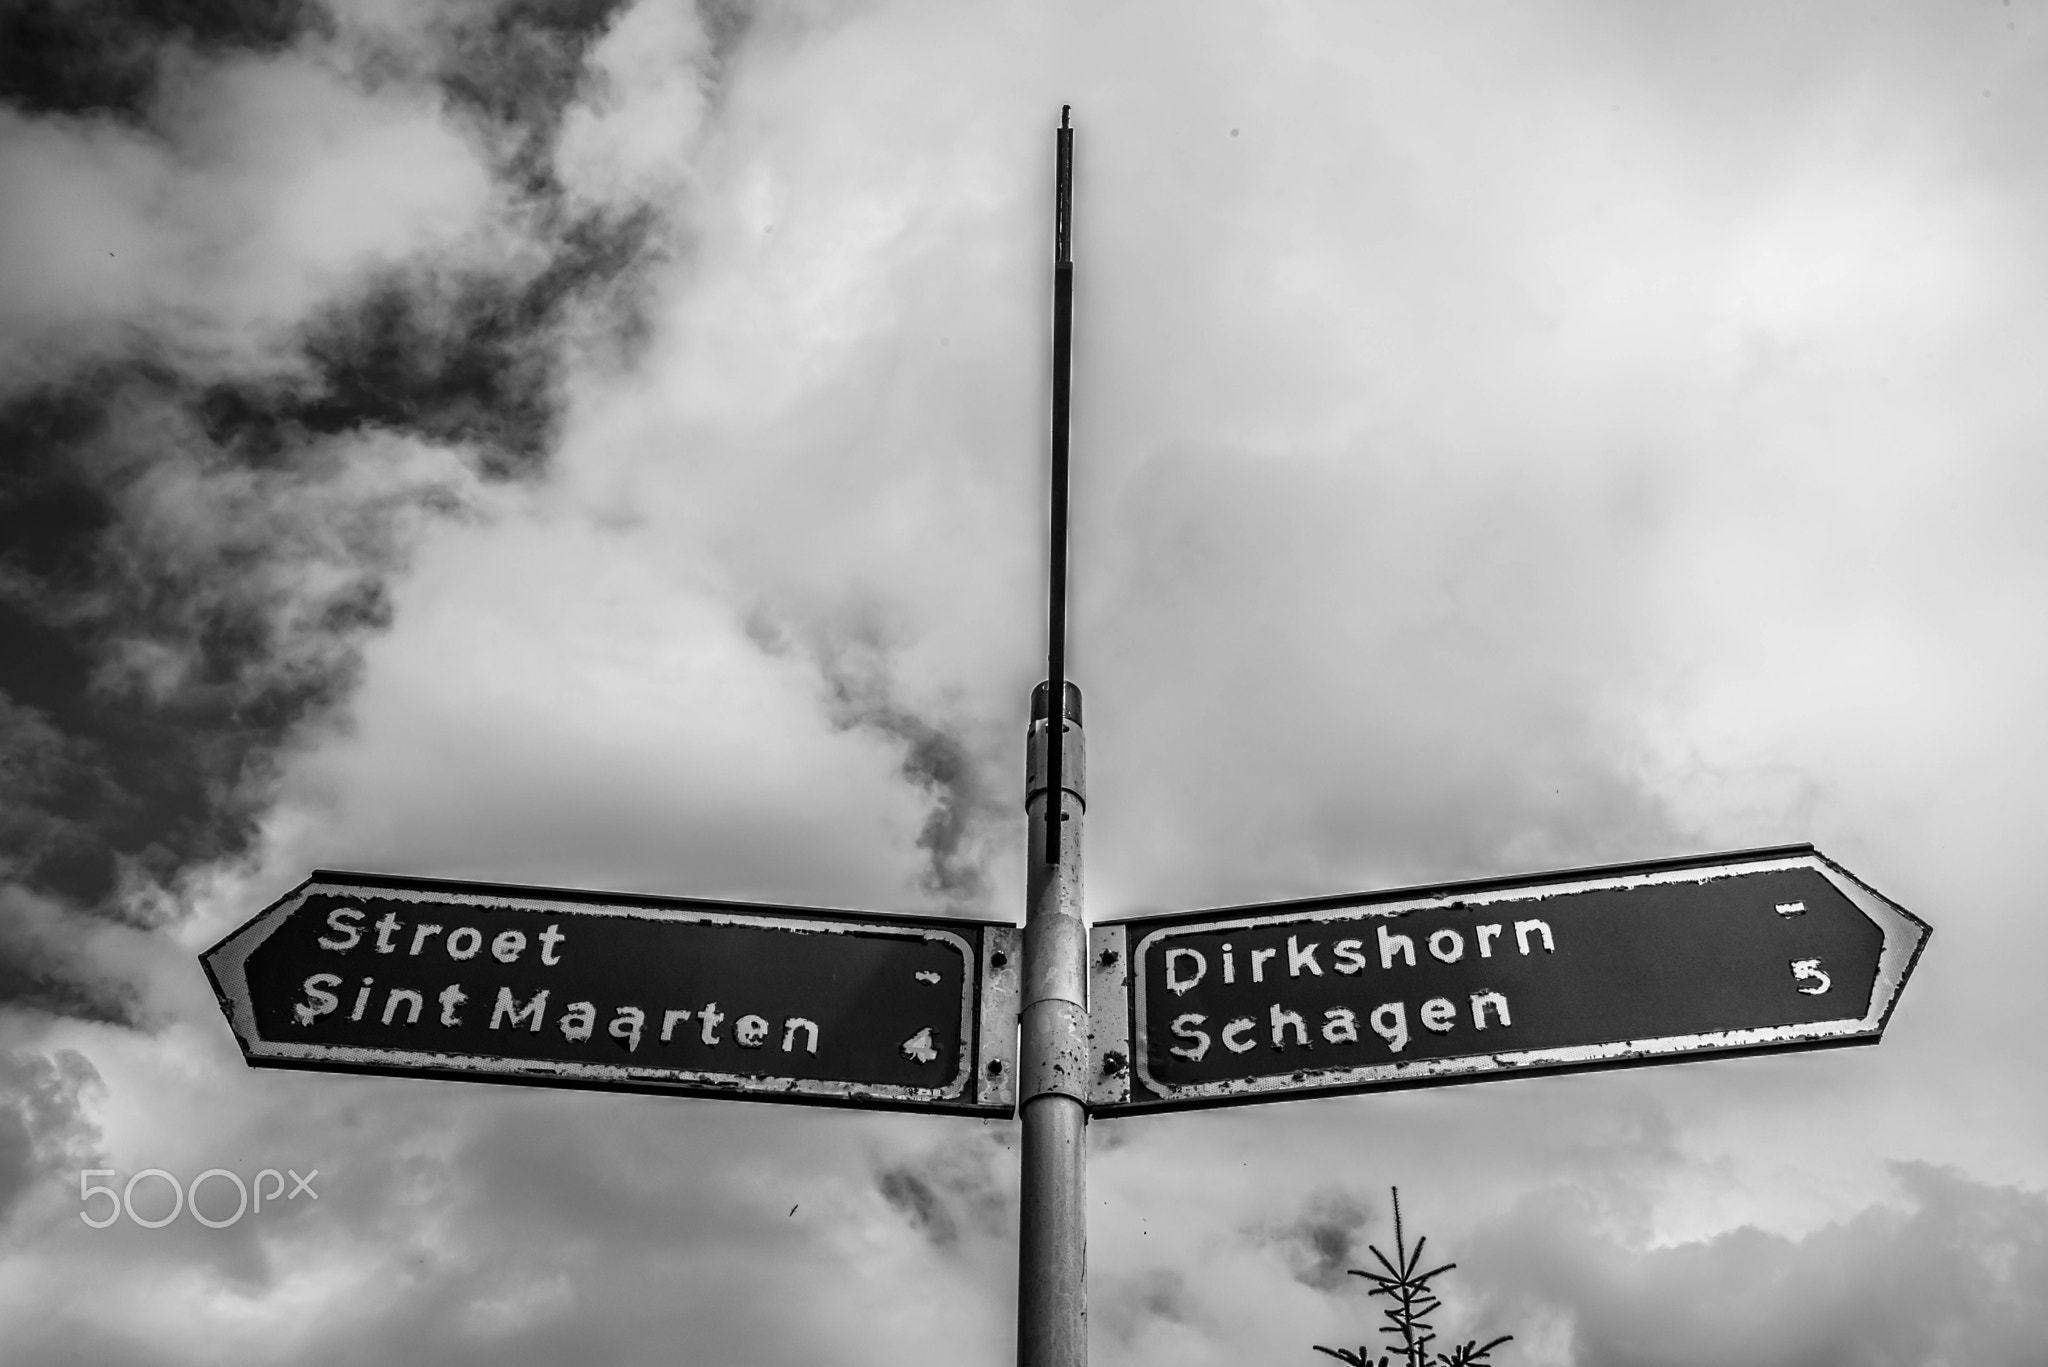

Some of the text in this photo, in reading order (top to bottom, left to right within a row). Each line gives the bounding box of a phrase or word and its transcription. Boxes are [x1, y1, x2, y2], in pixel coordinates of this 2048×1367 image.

[317, 907, 566, 967] Stroet
[1164, 919, 1555, 996] Dirkshorn
[292, 972, 939, 1063] Sint Maarten 4
[1168, 957, 1832, 1062] Schagen 5
